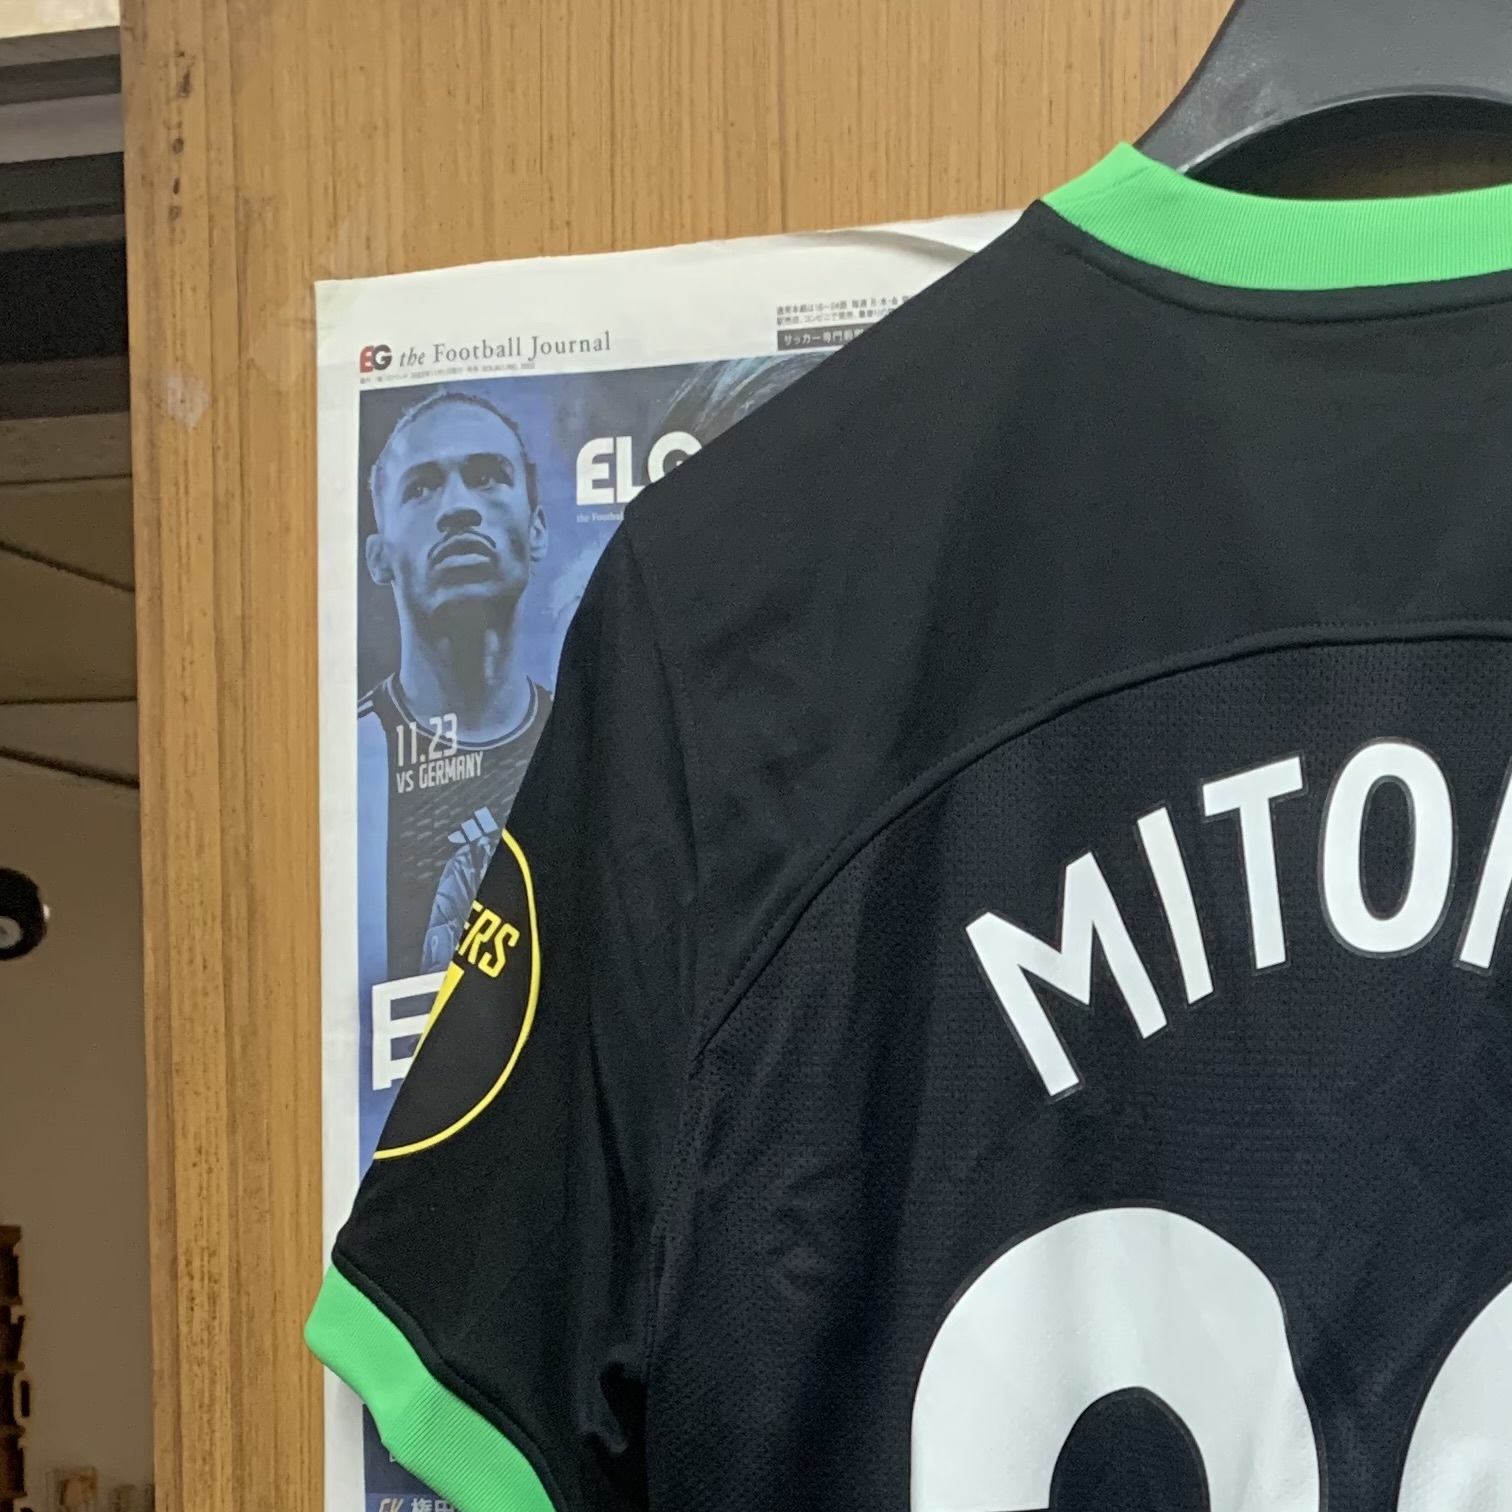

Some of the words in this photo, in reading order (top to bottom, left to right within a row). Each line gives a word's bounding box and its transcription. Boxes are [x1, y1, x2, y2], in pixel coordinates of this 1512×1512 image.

[400, 347, 425, 368] the
[433, 337, 522, 363] Football
[527, 330, 612, 362] Journal
[396, 712, 458, 766] 11.23
[396, 770, 414, 793] VS
[419, 751, 484, 789] GERMANY
